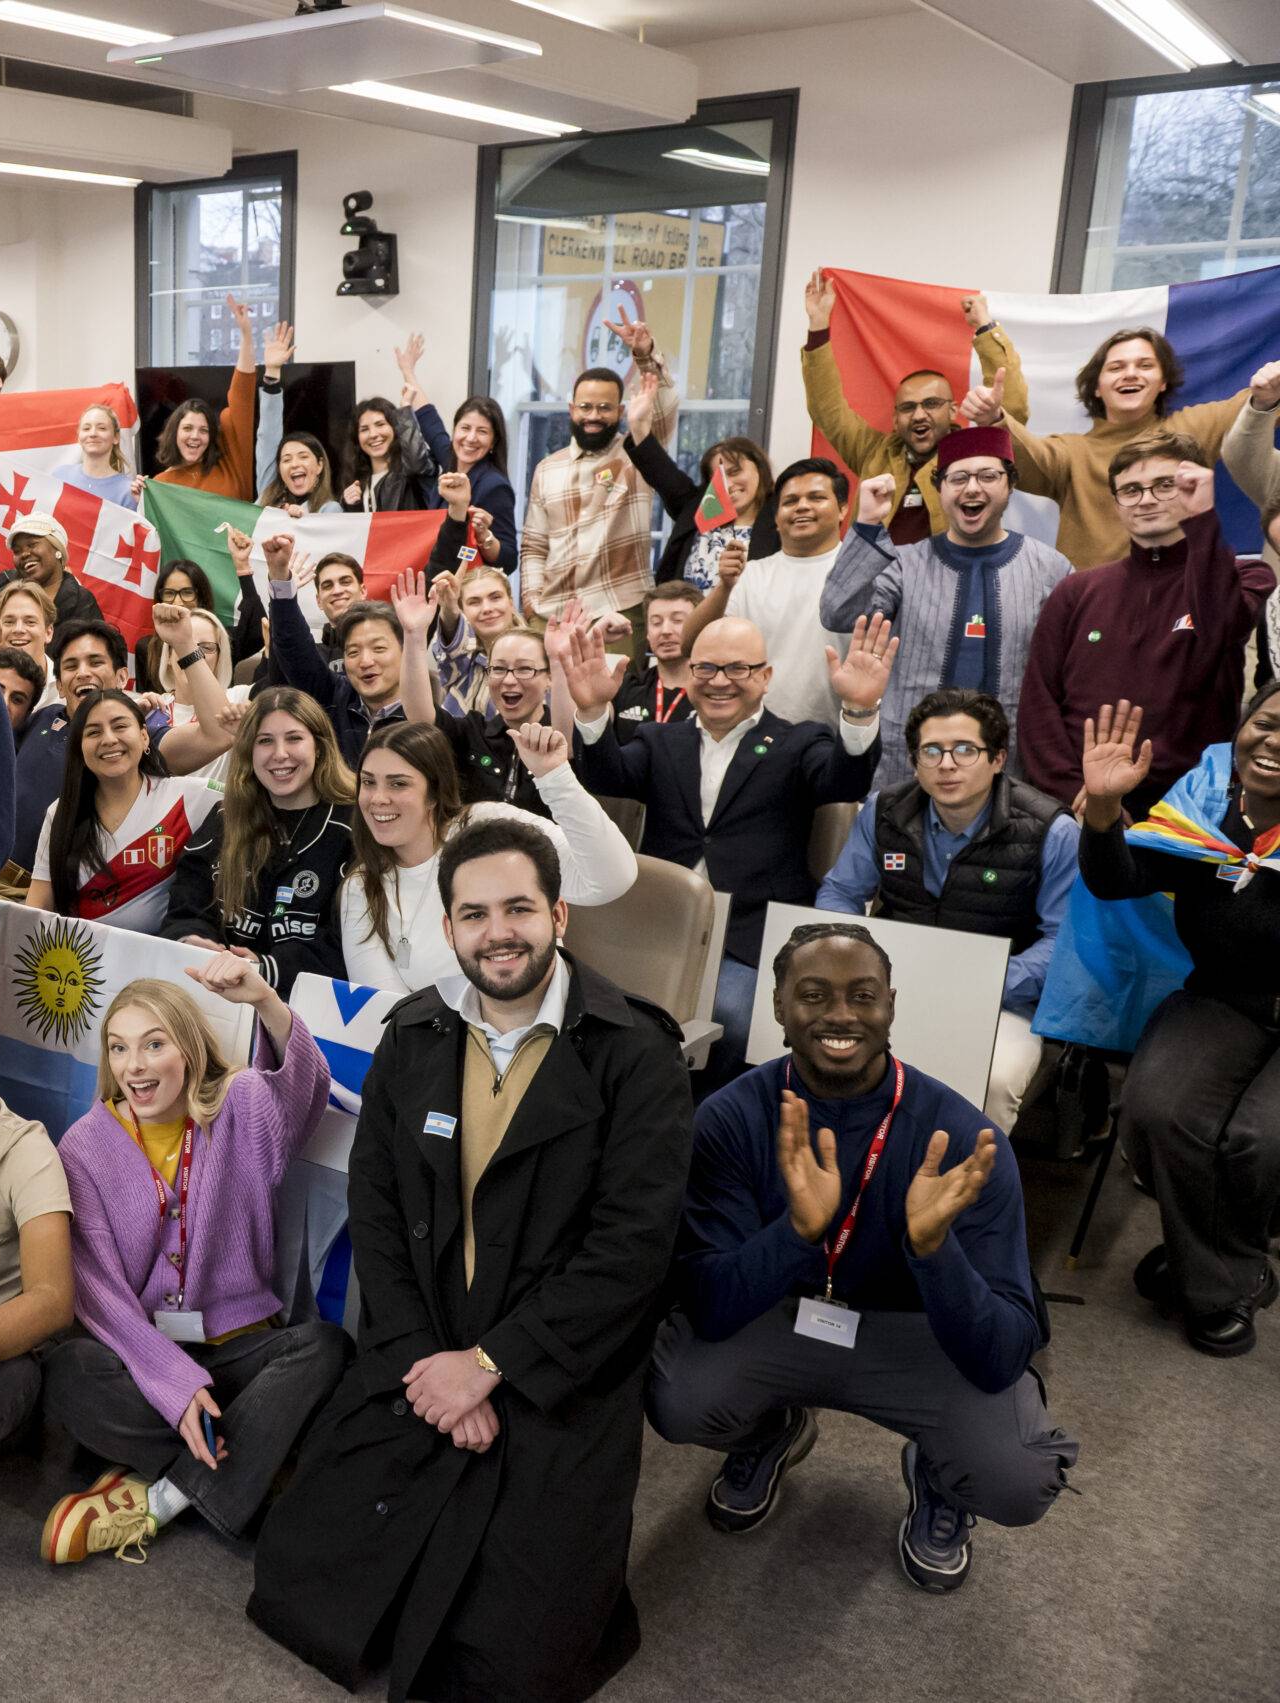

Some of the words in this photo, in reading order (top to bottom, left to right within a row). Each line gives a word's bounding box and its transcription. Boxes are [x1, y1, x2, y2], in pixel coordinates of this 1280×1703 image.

[600, 214, 642, 242] Brough
[548, 233, 626, 264] CLERKENWLL
[632, 247, 664, 268] ROAD
[864, 1153, 878, 1180] VISITOR
[156, 1180, 166, 1204] VISITOR
[834, 1230, 850, 1254] VISITOR
